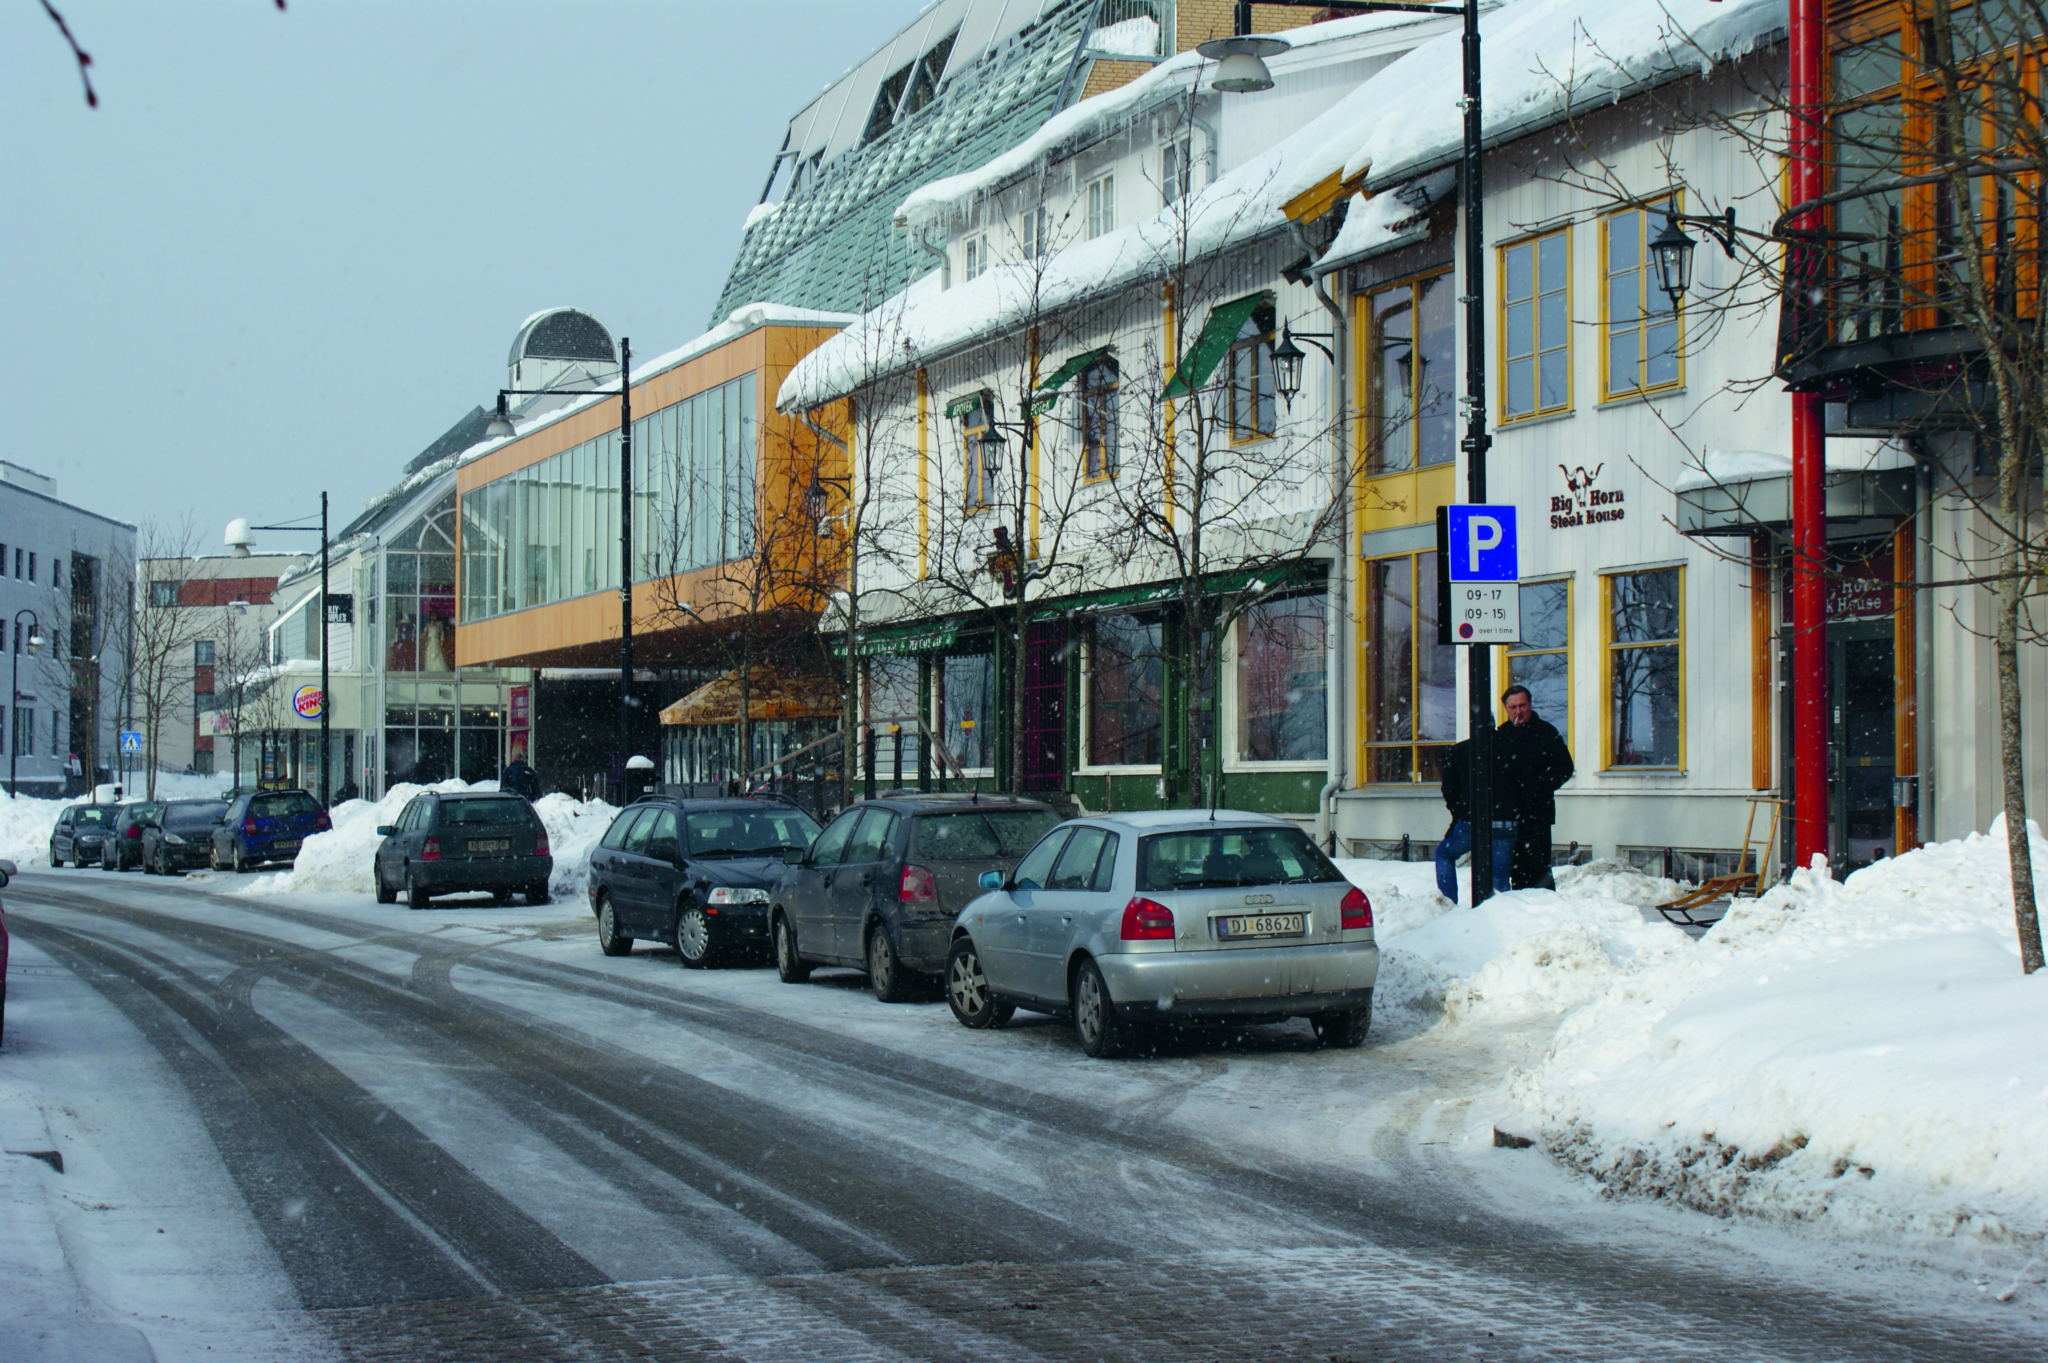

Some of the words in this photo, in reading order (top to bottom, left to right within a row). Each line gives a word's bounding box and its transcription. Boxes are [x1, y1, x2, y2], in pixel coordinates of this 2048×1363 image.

[953, 400, 973, 417] APOTEK
[1551, 495, 1572, 516] Big
[1590, 490, 1624, 506] Horn
[1550, 511, 1583, 529] Steak
[1586, 508, 1624, 524] House
[1468, 516, 1503, 572] P
[297, 690, 322, 704] BURGER
[1232, 920, 1248, 933] DJ
[1256, 916, 1300, 932] 68620
